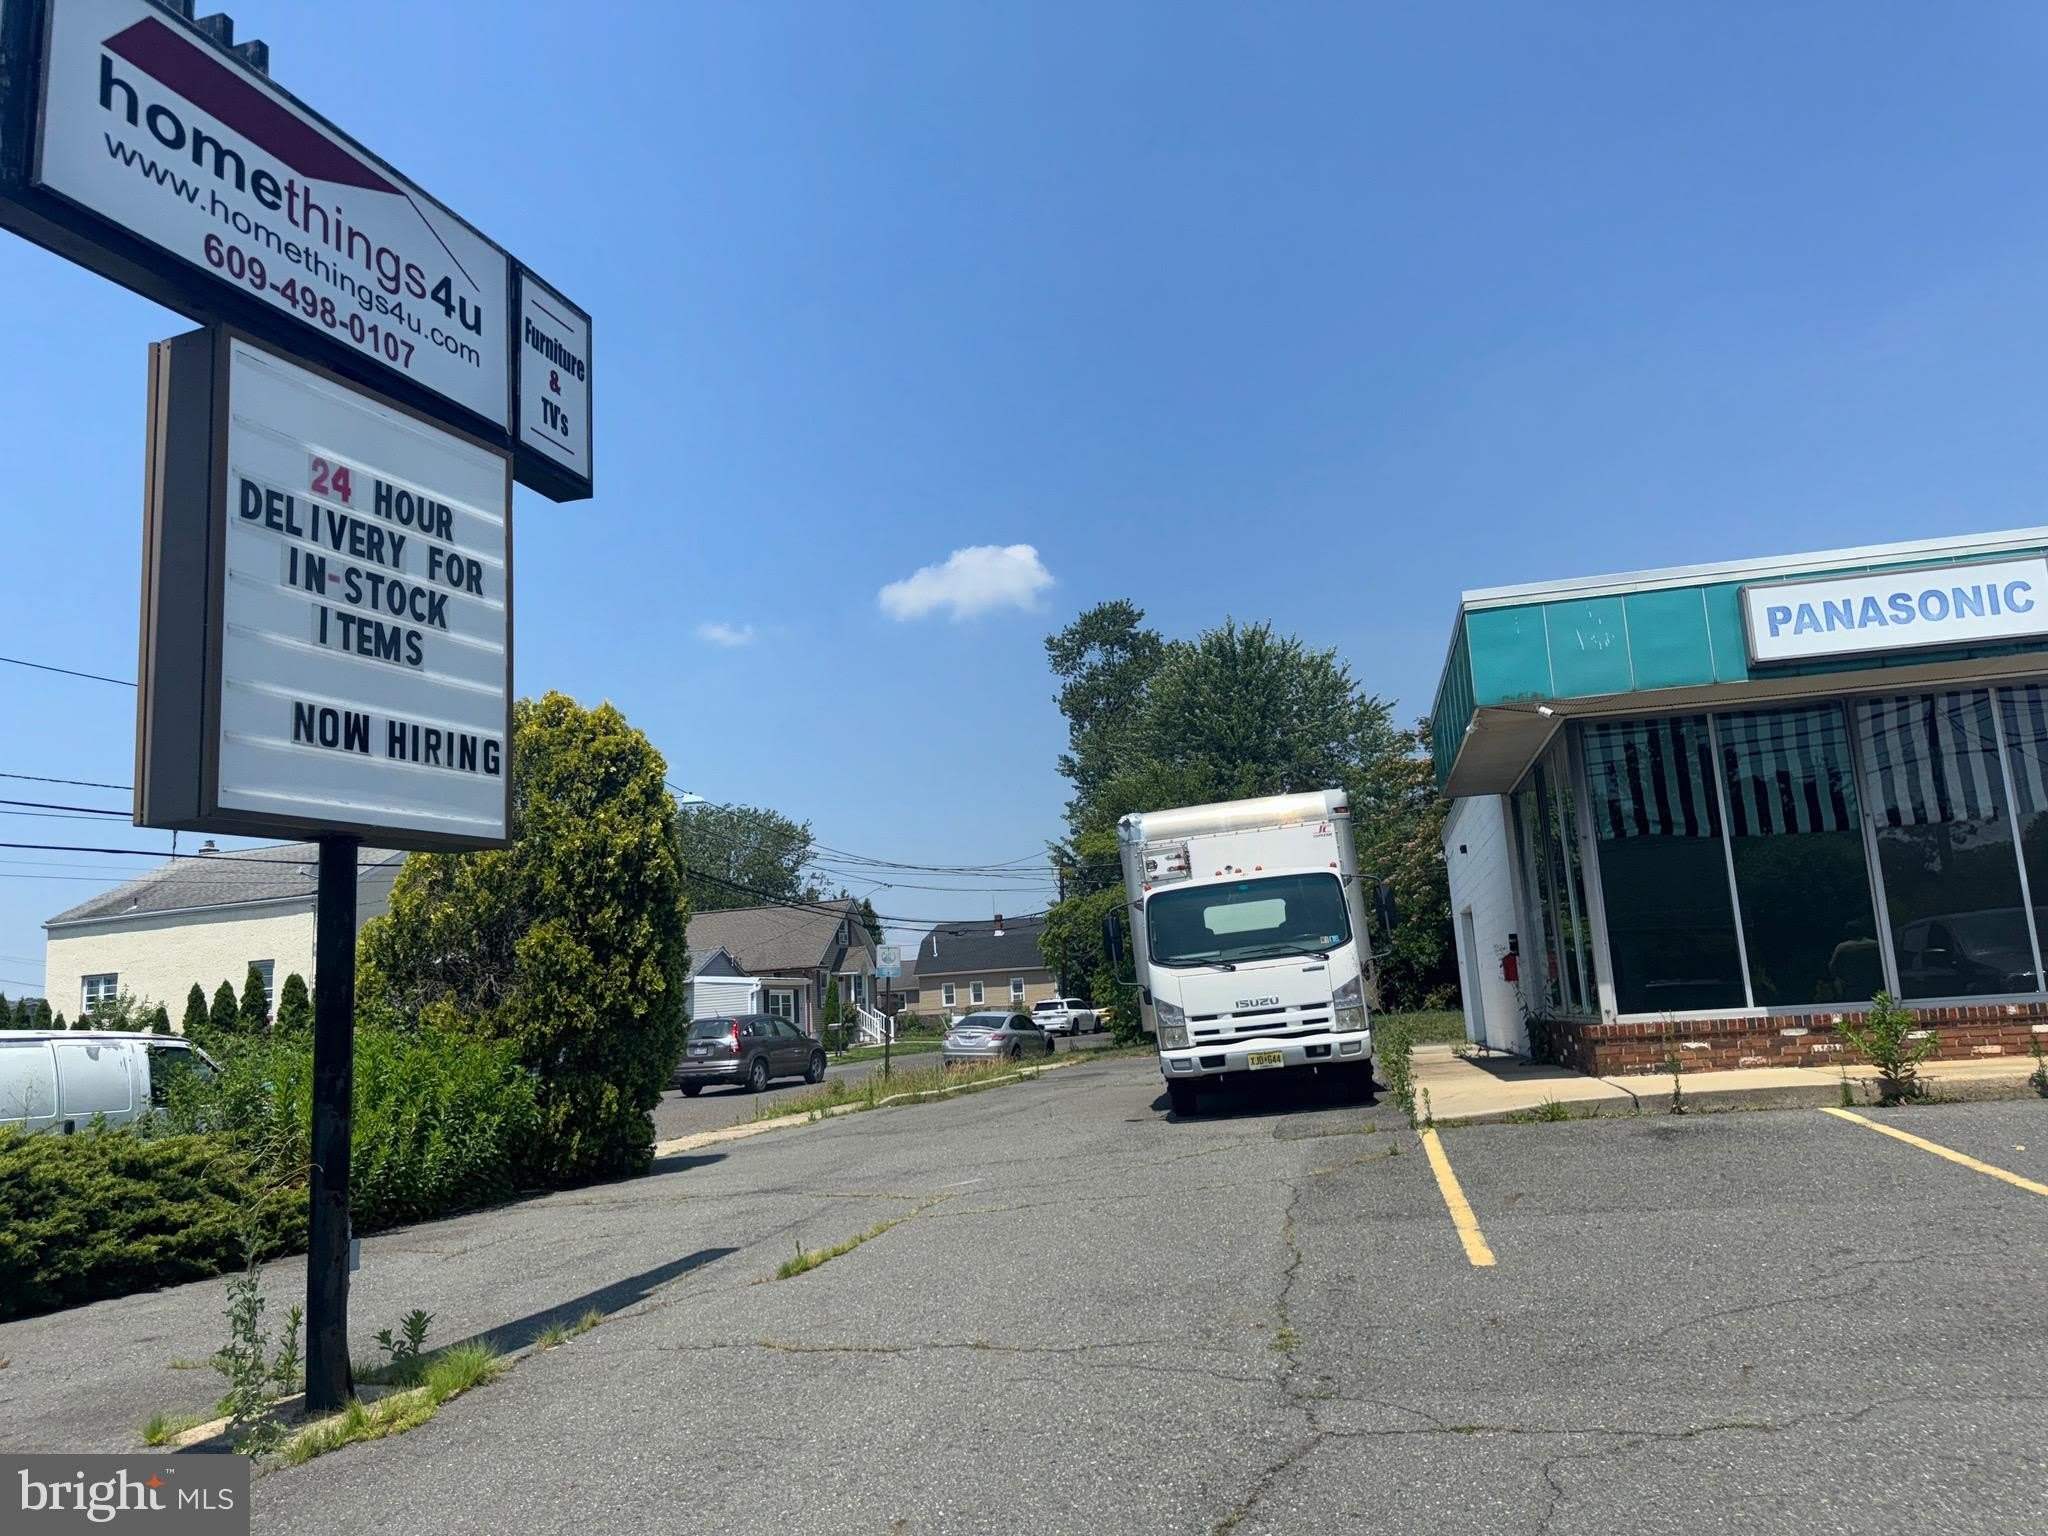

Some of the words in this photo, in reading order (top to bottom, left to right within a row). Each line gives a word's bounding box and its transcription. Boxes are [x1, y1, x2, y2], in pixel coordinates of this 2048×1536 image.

[99, 54, 482, 336] homethings4u
[104, 132, 481, 368] www.homethings4u.com
[203, 233, 416, 369] 609-498-0107
[525, 316, 585, 382] Furniture
[549, 369, 561, 396] &
[541, 396, 569, 437] TV's
[240, 478, 407, 569] DELIVERY
[428, 546, 484, 596] FOR
[311, 457, 352, 503] 24
[374, 479, 454, 542] HOUR
[289, 546, 449, 630] IN-STOCK
[1766, 580, 2035, 638] PANASONIC
[319, 605, 424, 666] ITEMS
[294, 701, 370, 754] NOW
[388, 721, 501, 776] HIRING
[1235, 996, 1280, 1009] ISUZU
